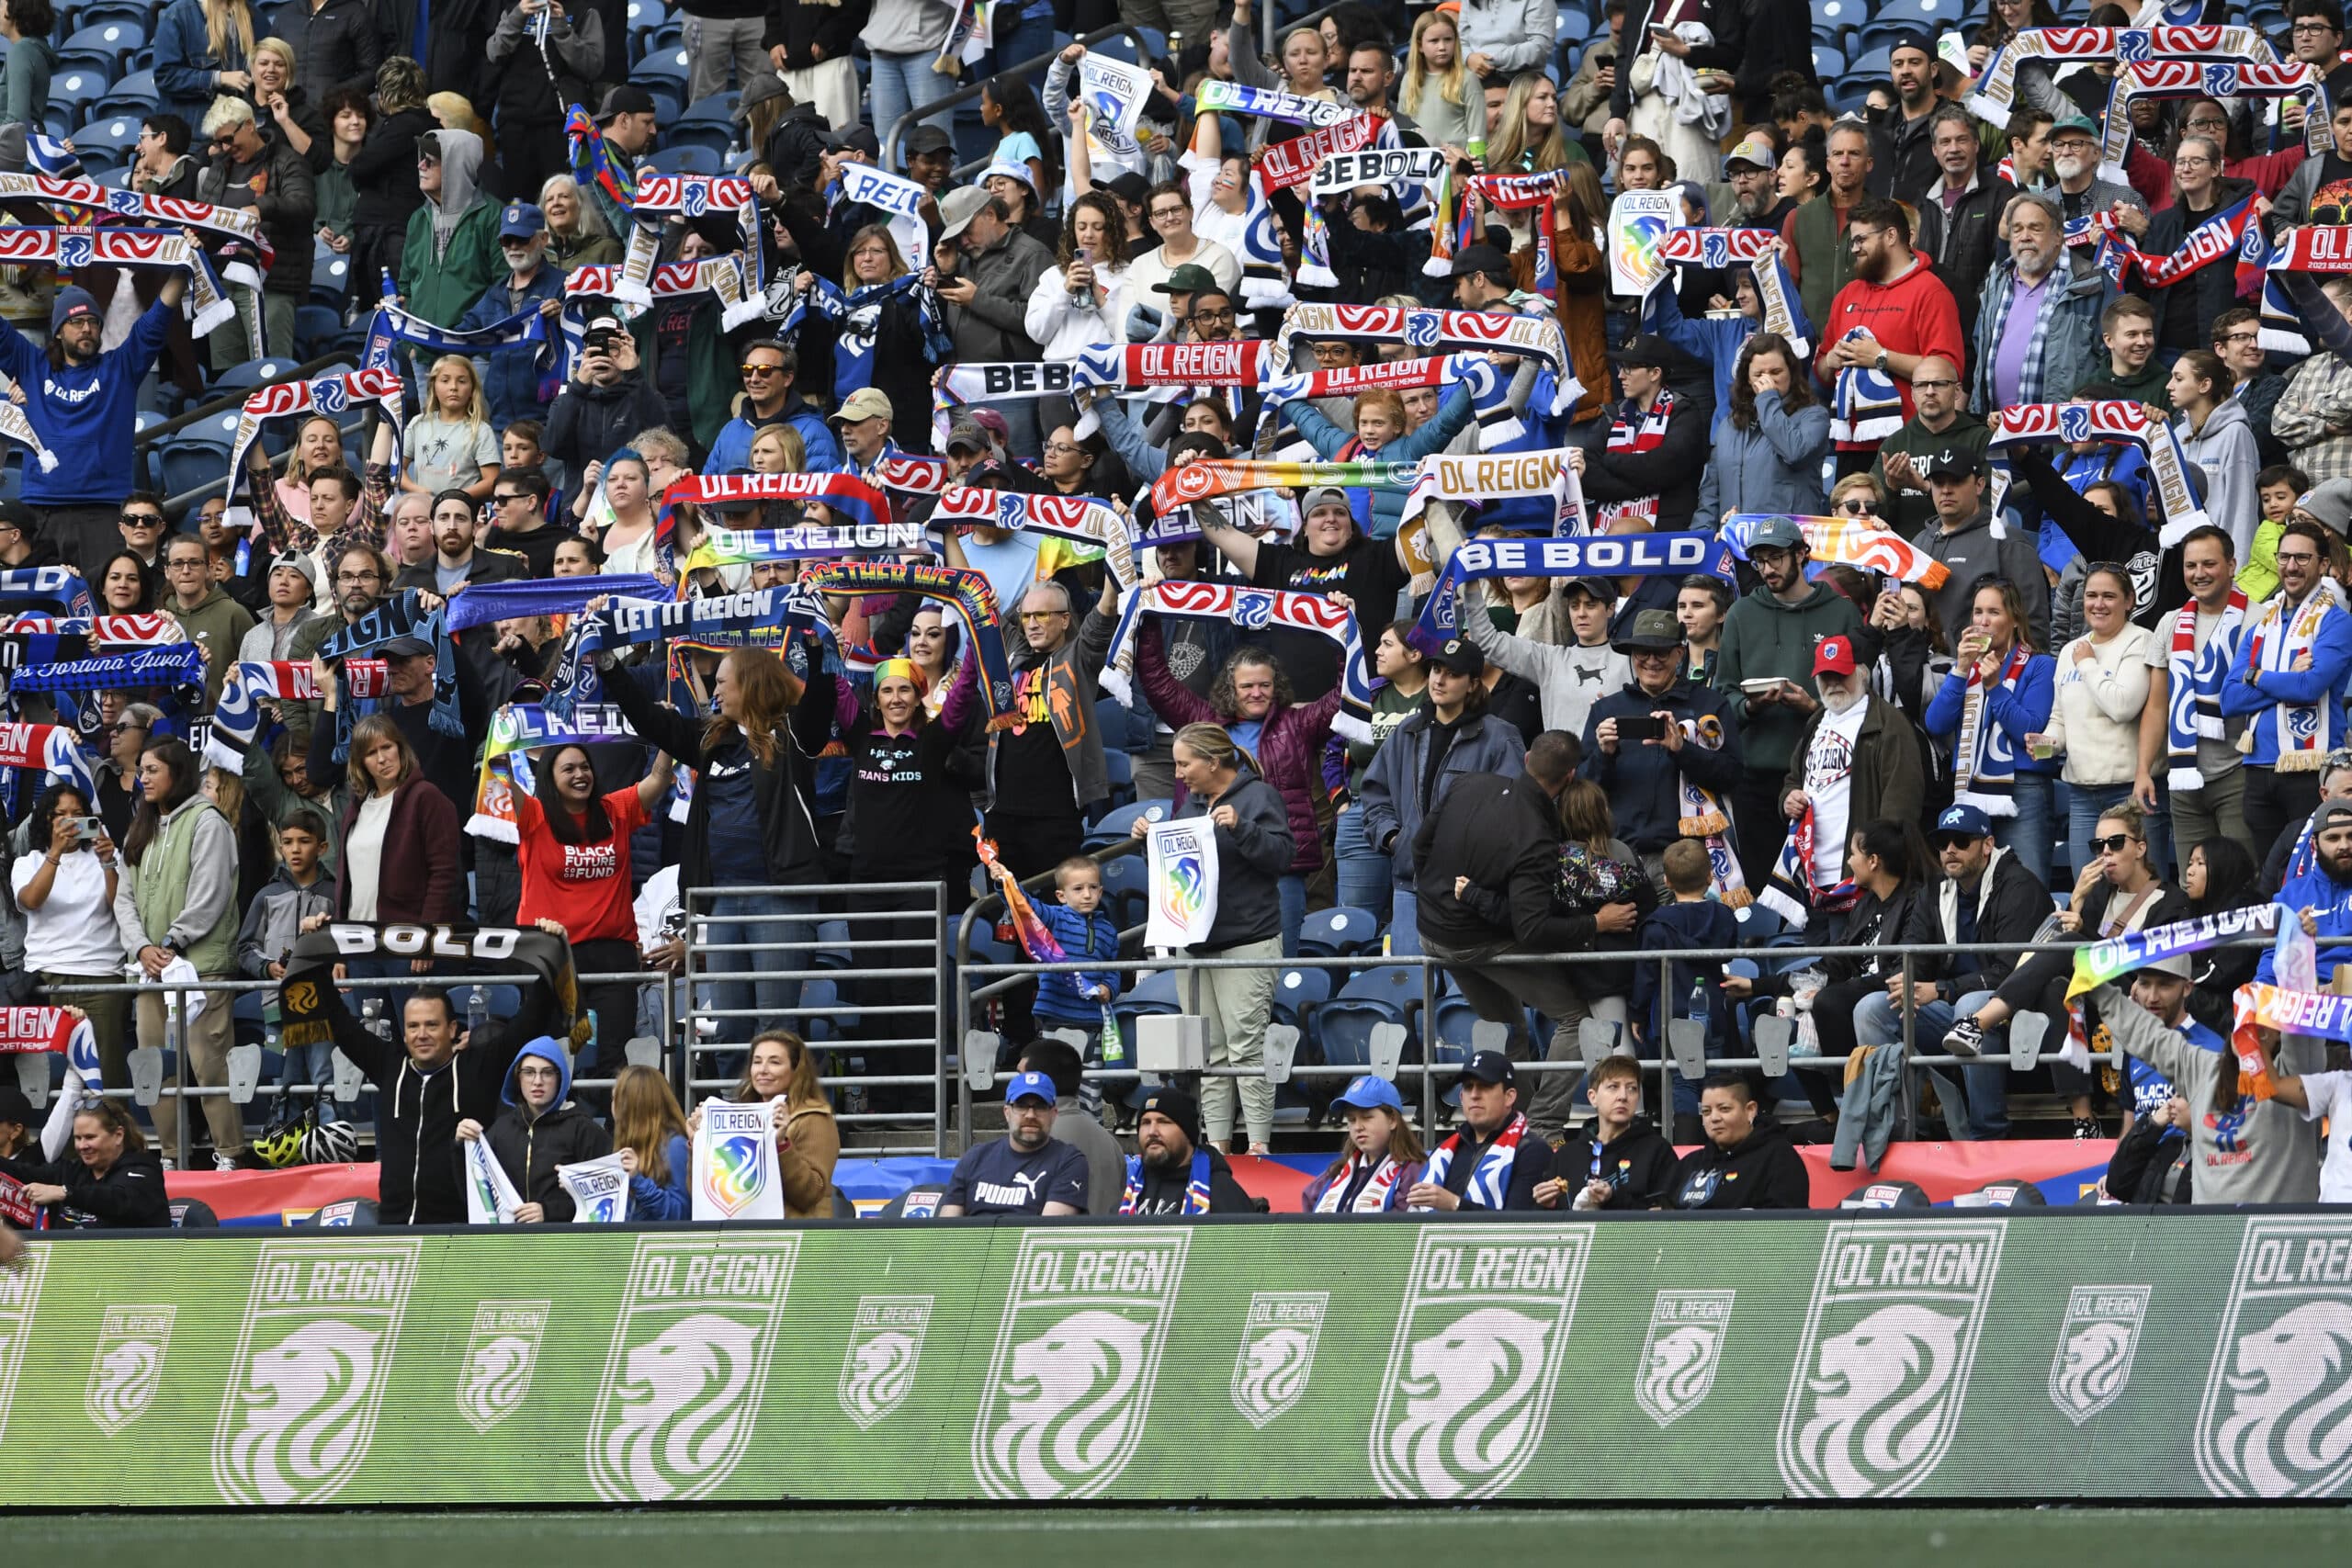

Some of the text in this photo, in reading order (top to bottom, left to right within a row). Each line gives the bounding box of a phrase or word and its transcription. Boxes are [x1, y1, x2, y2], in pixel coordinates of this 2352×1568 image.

[2223, 29, 2245, 52] OL
[1101, 73, 1134, 95] REIGN
[1203, 81, 1248, 108] OL
[1264, 114, 1372, 177] OL REIGN
[1316, 151, 1444, 186] BE BOLD
[1273, 178, 1292, 187] 2023
[1623, 197, 1670, 209] OL REIGN
[215, 209, 239, 229] OL
[162, 240, 186, 261] OL
[2311, 229, 2341, 260] OL
[1510, 321, 1535, 344] OL
[1141, 344, 1243, 376] OL REIGN
[985, 364, 1037, 394] BE
[1143, 378, 1159, 387] 2023
[1159, 378, 1188, 387] SEASON
[1215, 378, 1243, 386] MEMBER
[1398, 376, 1426, 386] MEMBER
[742, 473, 834, 496] REIGN
[1301, 463, 1346, 485] IS
[1441, 456, 1561, 494] OL REIGN
[2151, 445, 2191, 517] REIGN
[1085, 509, 1107, 537] OL
[713, 522, 921, 557] OL REIGN
[1457, 537, 1706, 571] BE BOLD
[1, 566, 68, 592] LD
[801, 561, 907, 589] OGETHER
[914, 566, 956, 592] WE
[615, 605, 658, 634] LET
[692, 589, 775, 621] REIGN
[37, 649, 195, 678] Fortuna Juvat
[858, 770, 922, 783] TRANS KIDS
[565, 844, 616, 858] BLACK
[565, 855, 616, 867] FUTURE
[576, 867, 615, 879] FUND
[331, 923, 521, 960] BOLD
[2090, 903, 2278, 976] OL REIGN
[21, 1040, 51, 1051] MEMBER
[2134, 1084, 2175, 1100] BLACK
[714, 1112, 763, 1130] OL REIGN
[578, 1175, 621, 1197] OL REIGN
[975, 1181, 1029, 1207] PUMA
[1029, 1250, 1170, 1294] OL REIGN
[1426, 1247, 1572, 1291] OL REIGN
[1836, 1243, 1984, 1287] OL REIGN
[2253, 1239, 2352, 1282] OL REI
[266, 1259, 401, 1303] OL REIGN
[642, 1253, 781, 1297] OL REIGN
[863, 1307, 879, 1325] OL
[1255, 1303, 1274, 1322] OL
[1660, 1300, 1724, 1320] OL REIGN
[2074, 1295, 2139, 1316] OL REIGN
[482, 1310, 499, 1329] OL
